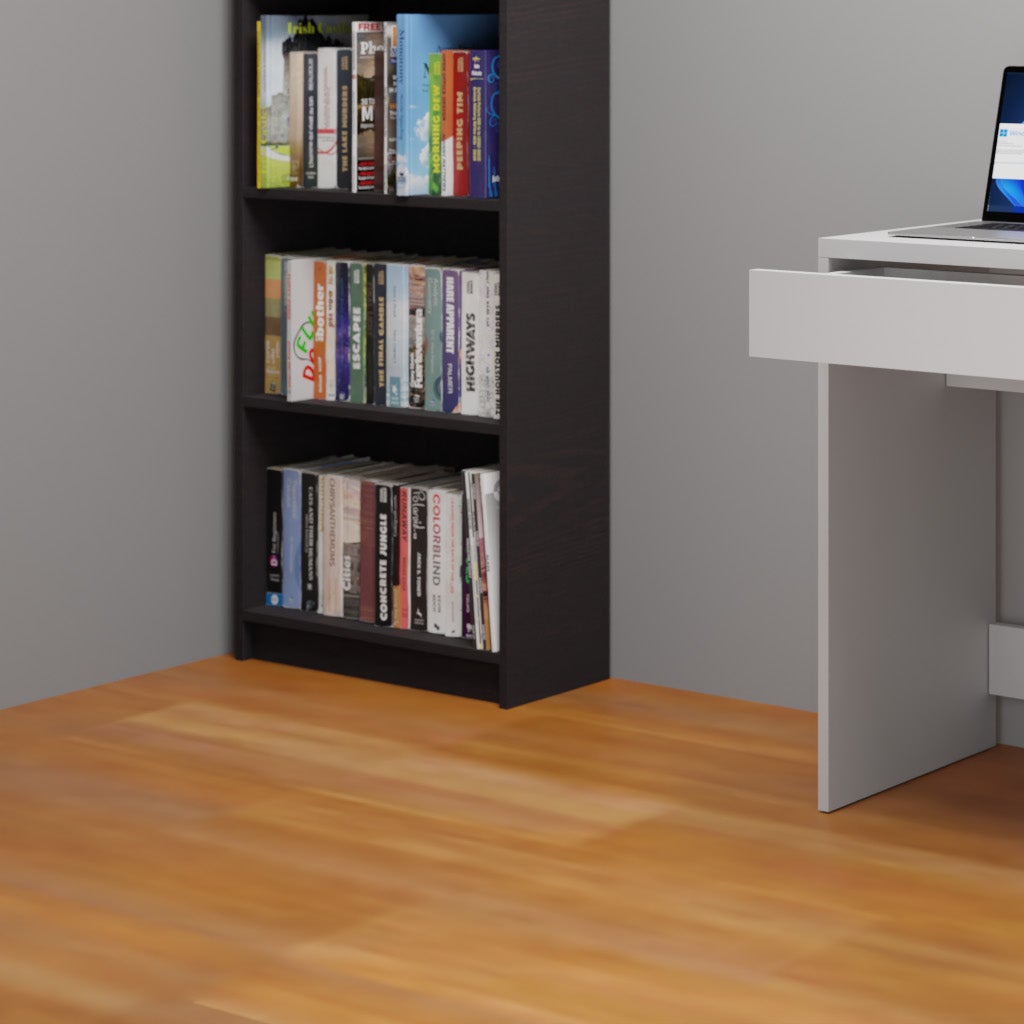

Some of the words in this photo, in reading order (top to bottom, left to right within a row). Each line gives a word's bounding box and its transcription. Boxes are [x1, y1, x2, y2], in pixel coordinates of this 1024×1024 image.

[358, 23, 381, 31] FREE
[456, 91, 464, 115] TIM
[456, 118, 464, 171] PEEPING
[445, 276, 454, 302] HARE
[352, 306, 361, 370] ESCAPEE
[445, 304, 454, 355] APPARENT
[465, 313, 475, 392] HIGHWAYS
[328, 478, 336, 568] CHRYSANTHEMUMS
[379, 513, 388, 557] JUNGLE
[432, 494, 441, 586] COLORBLIND
[379, 559, 388, 622] CONCRETE
